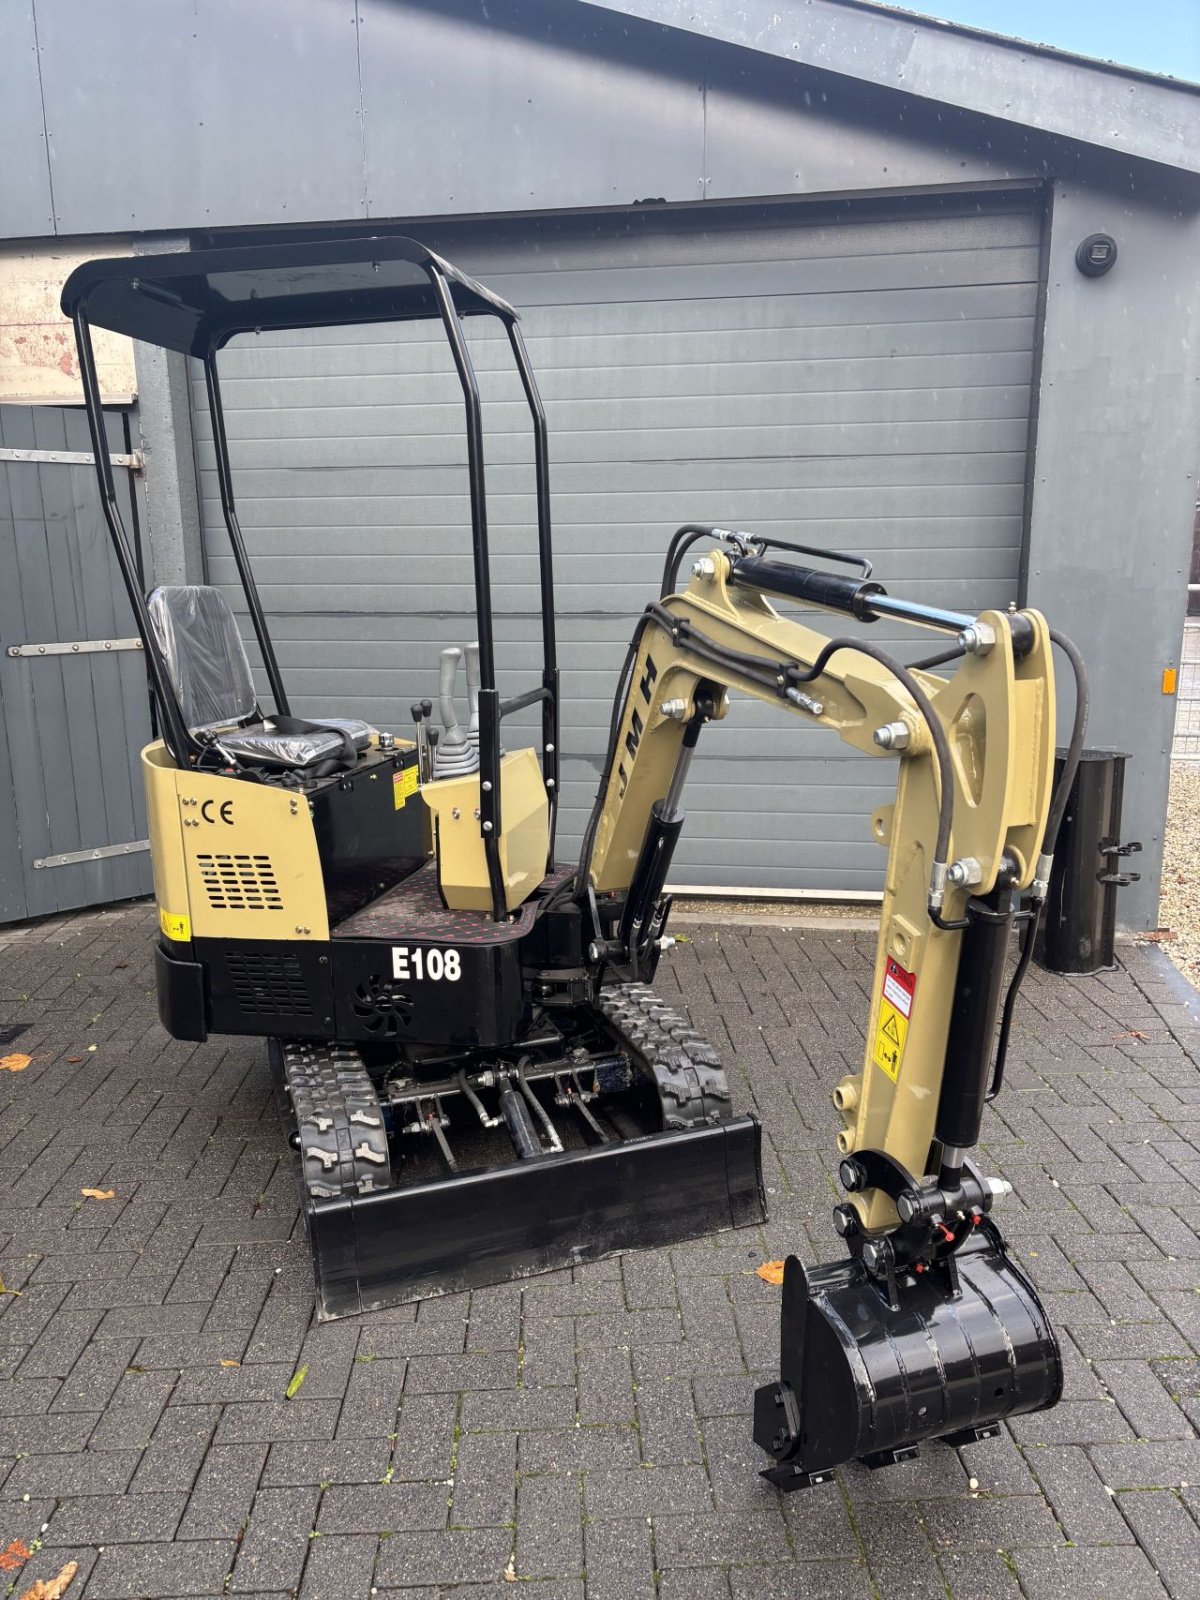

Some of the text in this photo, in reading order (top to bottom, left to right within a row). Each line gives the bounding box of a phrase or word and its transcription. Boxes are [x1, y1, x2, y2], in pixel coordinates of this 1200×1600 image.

[618, 653, 658, 800] JMH
[201, 799, 234, 825] CE
[392, 946, 462, 982] E108
